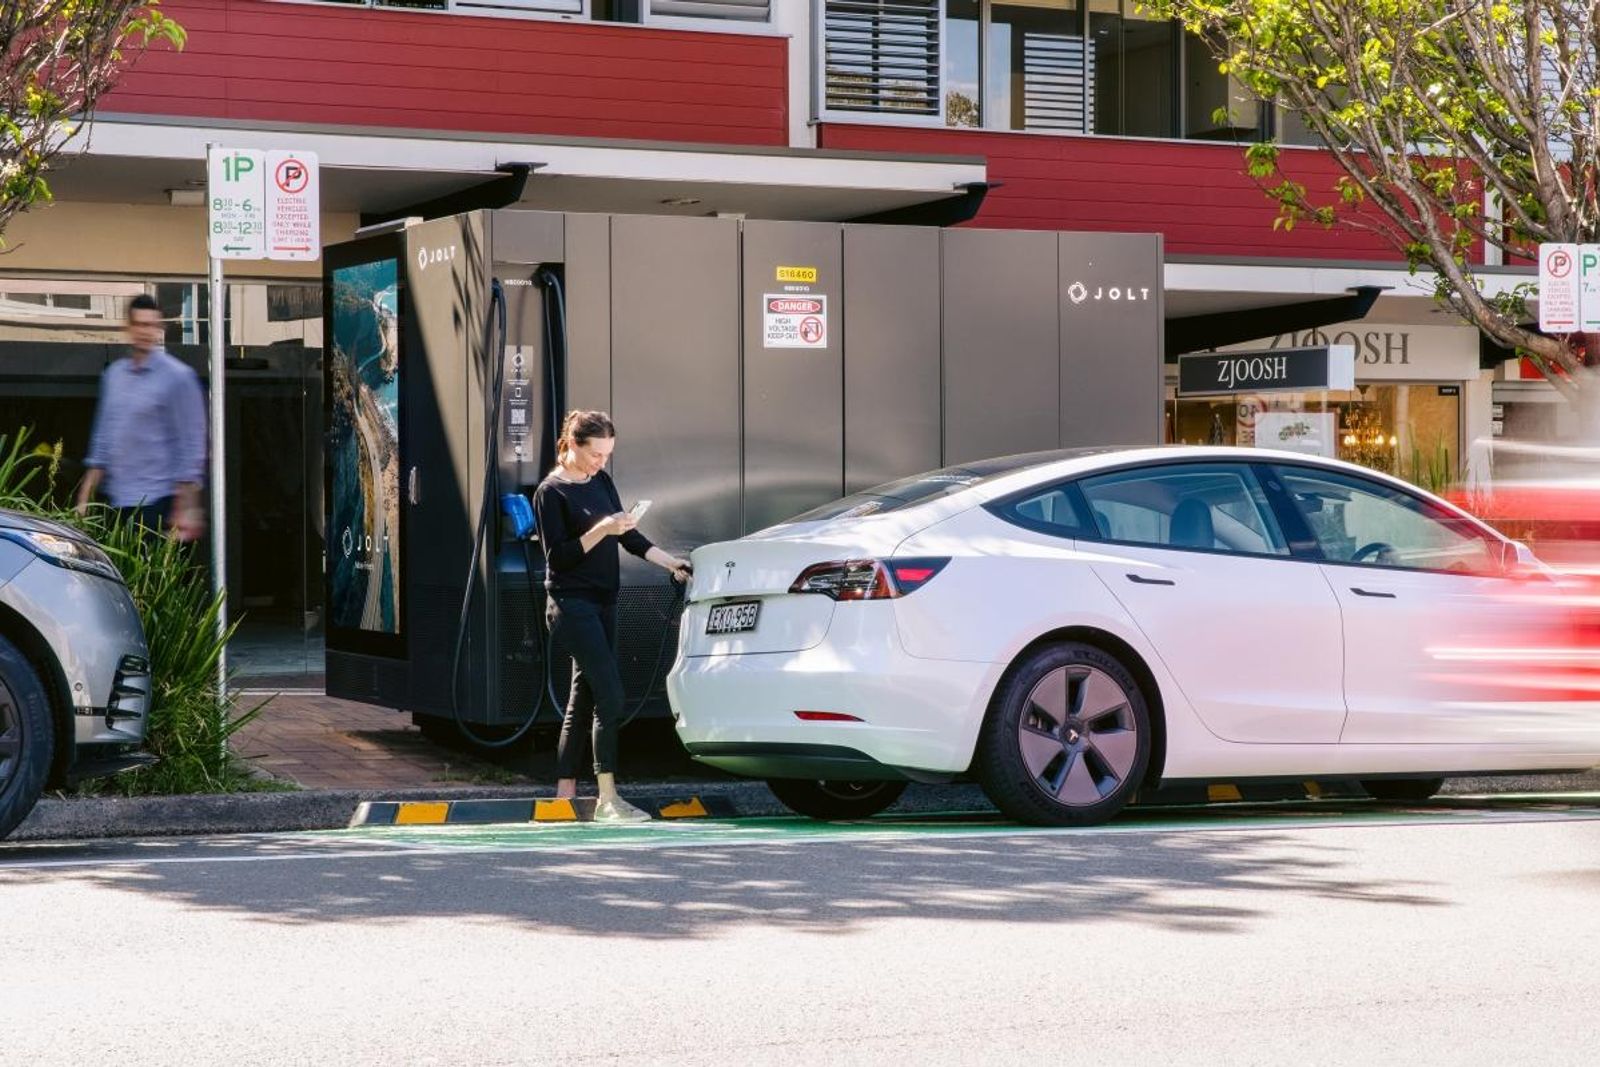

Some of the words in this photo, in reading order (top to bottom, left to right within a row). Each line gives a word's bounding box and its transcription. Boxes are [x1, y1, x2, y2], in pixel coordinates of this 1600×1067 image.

[222, 156, 255, 182] 1P
[429, 245, 456, 263] JOLT
[1094, 287, 1149, 300] JOLT
[778, 302, 813, 310] DANGER
[1217, 356, 1287, 388] ZJOOSH
[356, 533, 389, 553] JOLT
